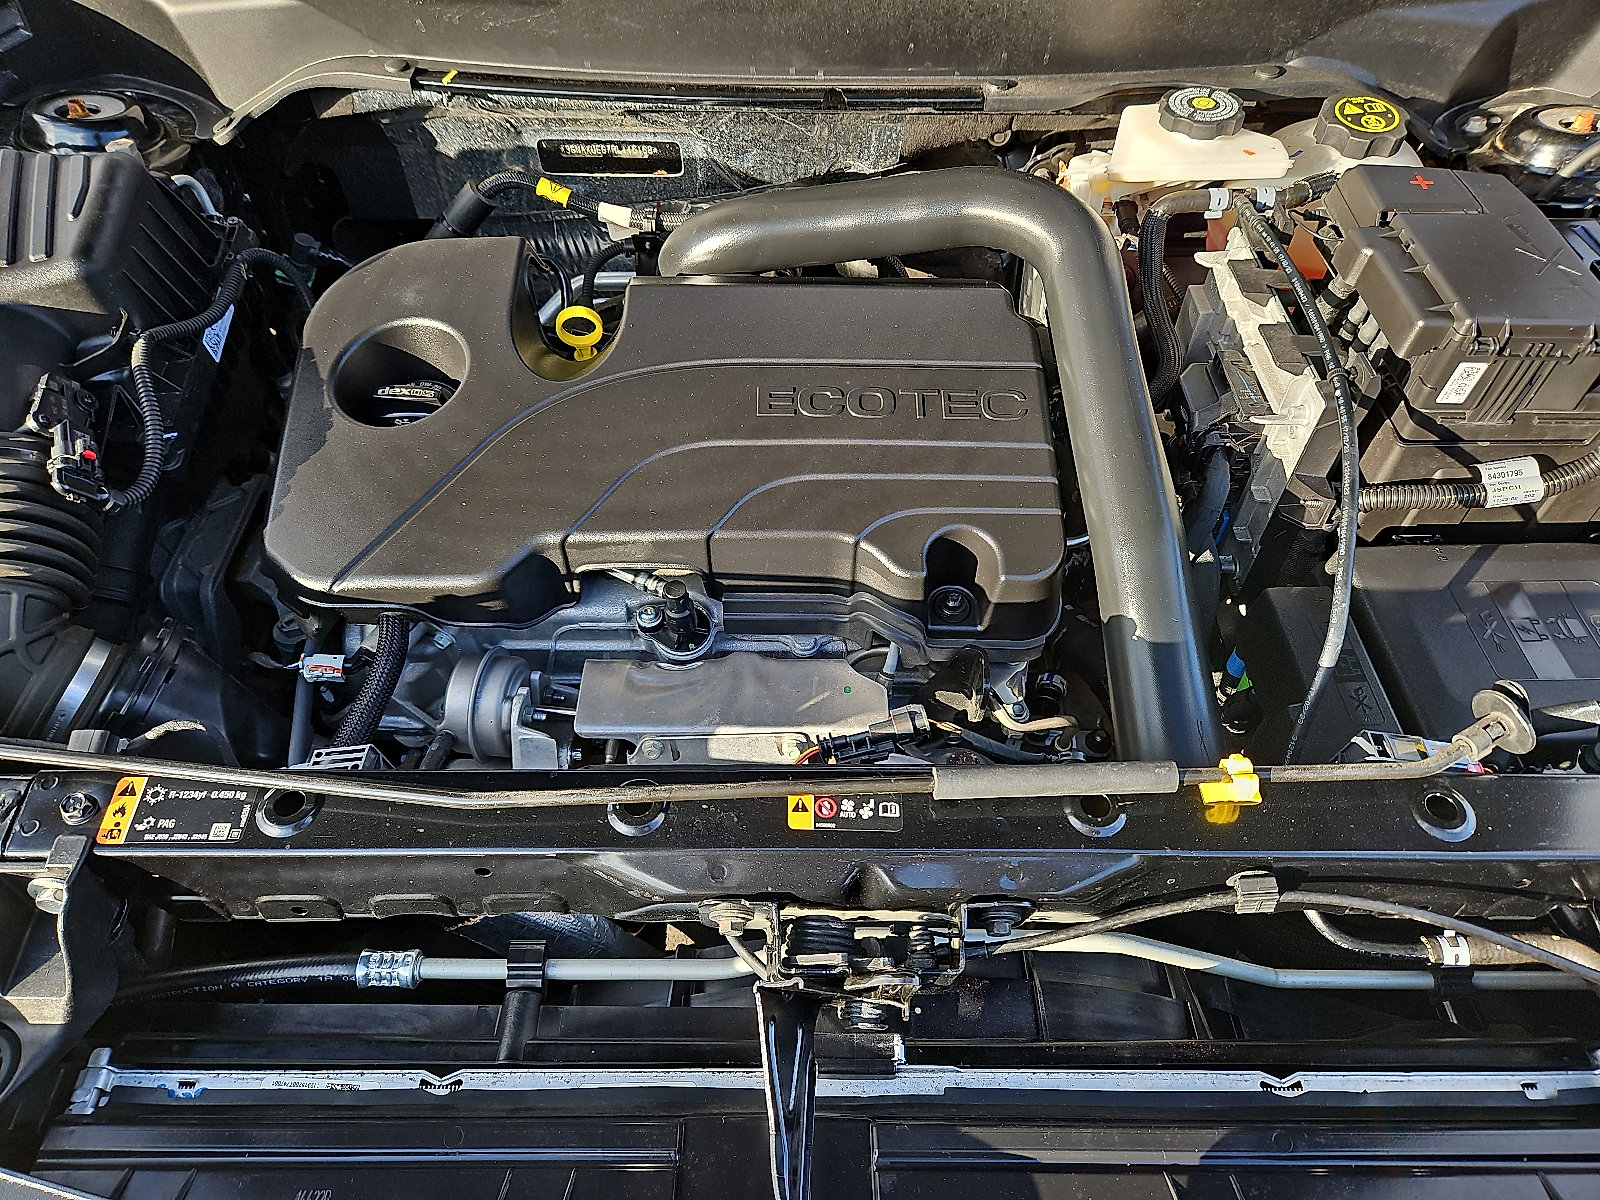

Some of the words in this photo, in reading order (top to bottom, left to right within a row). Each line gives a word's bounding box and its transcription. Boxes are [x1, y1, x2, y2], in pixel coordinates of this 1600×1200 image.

[377, 386, 435, 398] dexos
[756, 385, 1029, 421] ECOTEC
[168, 790, 208, 800] R-1234yf
[210, 790, 235, 800] 0.450
[234, 790, 248, 801] kg
[839, 810, 856, 818] AUTO
[157, 819, 176, 829] PAG
[247, 976, 308, 987] CATEGORY
